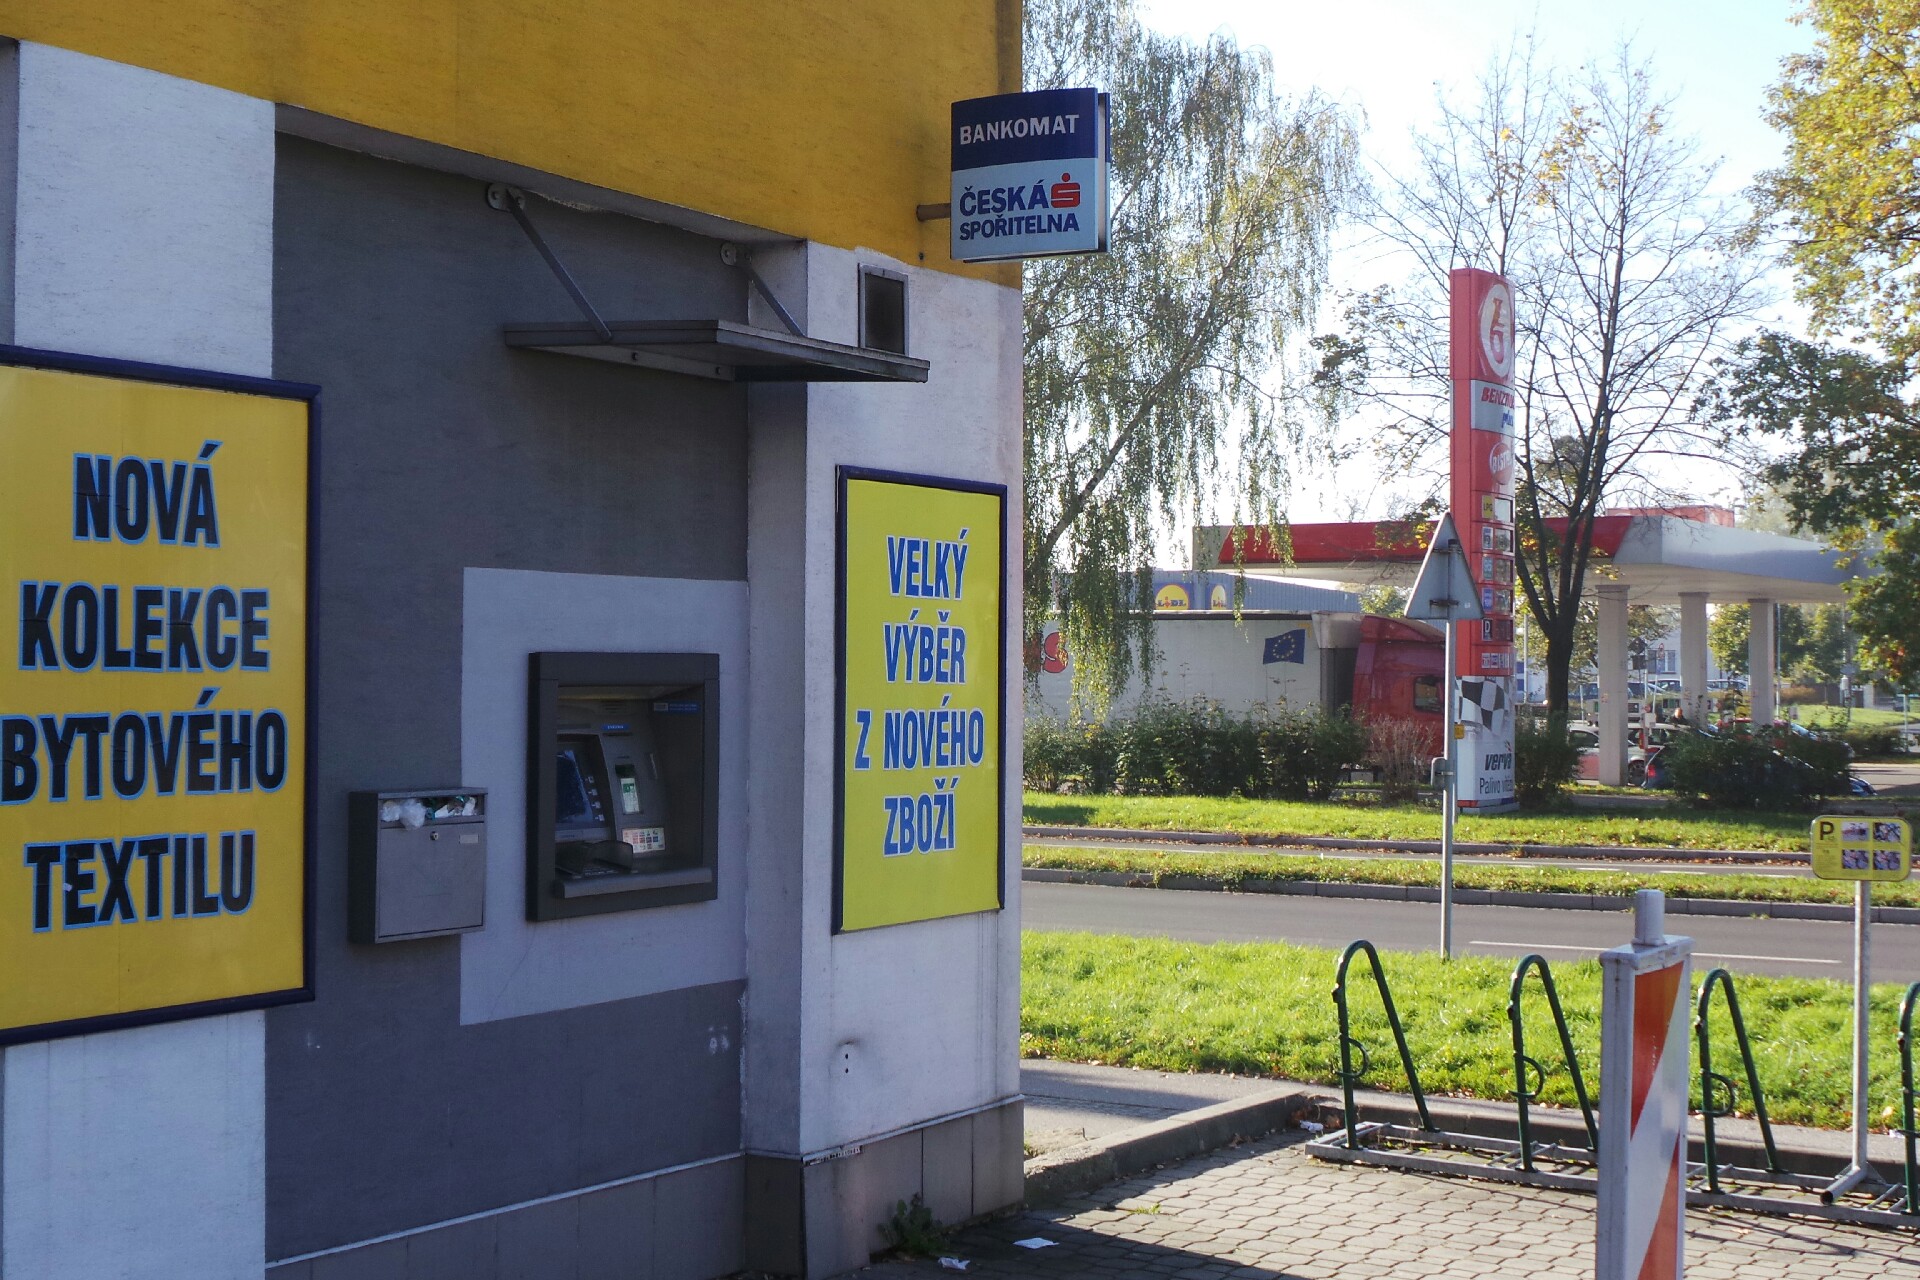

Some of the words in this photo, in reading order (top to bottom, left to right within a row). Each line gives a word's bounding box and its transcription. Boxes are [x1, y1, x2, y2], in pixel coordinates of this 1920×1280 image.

[960, 114, 1080, 145] BANKOMAT
[959, 179, 1049, 217] ČESKÁ
[959, 213, 1080, 241] SPOŘITELNA
[72, 440, 222, 548] NOVÁ
[886, 527, 969, 599] VELKÝ
[18, 581, 270, 673] KOLEKCE
[1157, 596, 1186, 609] LIDL
[882, 608, 966, 685] VÝBĚR
[0, 686, 288, 806] BYTOVÉHO
[853, 709, 872, 771] Z
[882, 695, 984, 772] NOVÉHO
[882, 778, 959, 857] ZBOŽÍ
[1479, 777, 1501, 795] Palivo
[1819, 821, 1835, 841] P
[23, 829, 256, 934] TEXTILU
